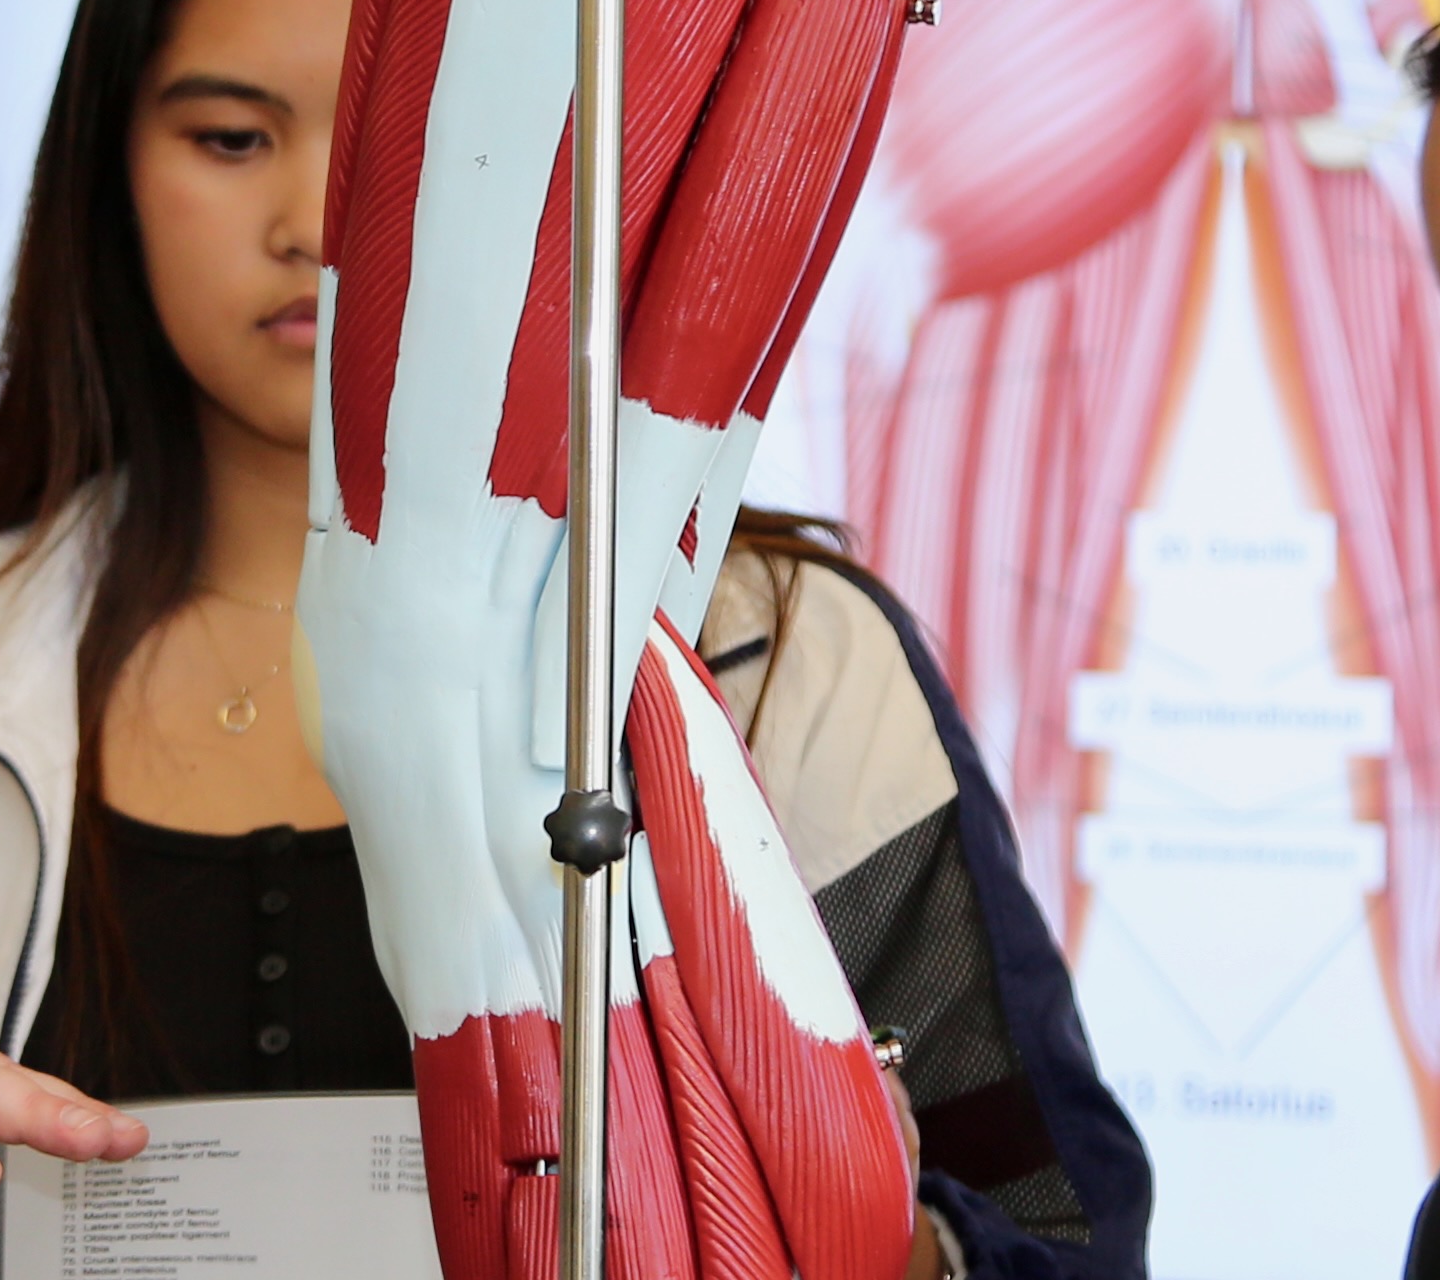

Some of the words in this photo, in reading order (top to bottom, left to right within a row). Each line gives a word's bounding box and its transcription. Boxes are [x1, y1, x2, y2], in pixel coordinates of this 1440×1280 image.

[131, 1175, 179, 1185] ligament
[127, 1187, 155, 1195] head
[136, 1198, 166, 1206] fossa
[84, 1211, 121, 1219] Medial
[125, 1209, 169, 1219] condyle
[172, 1208, 184, 1216] of
[187, 1208, 219, 1216] femur
[84, 1223, 121, 1231] Lateral
[126, 1221, 169, 1231] condyle
[83, 1234, 126, 1242] Oblique
[181, 1230, 230, 1240] ligament
[84, 1245, 109, 1253] Tibia
[83, 1267, 120, 1275] Medial
